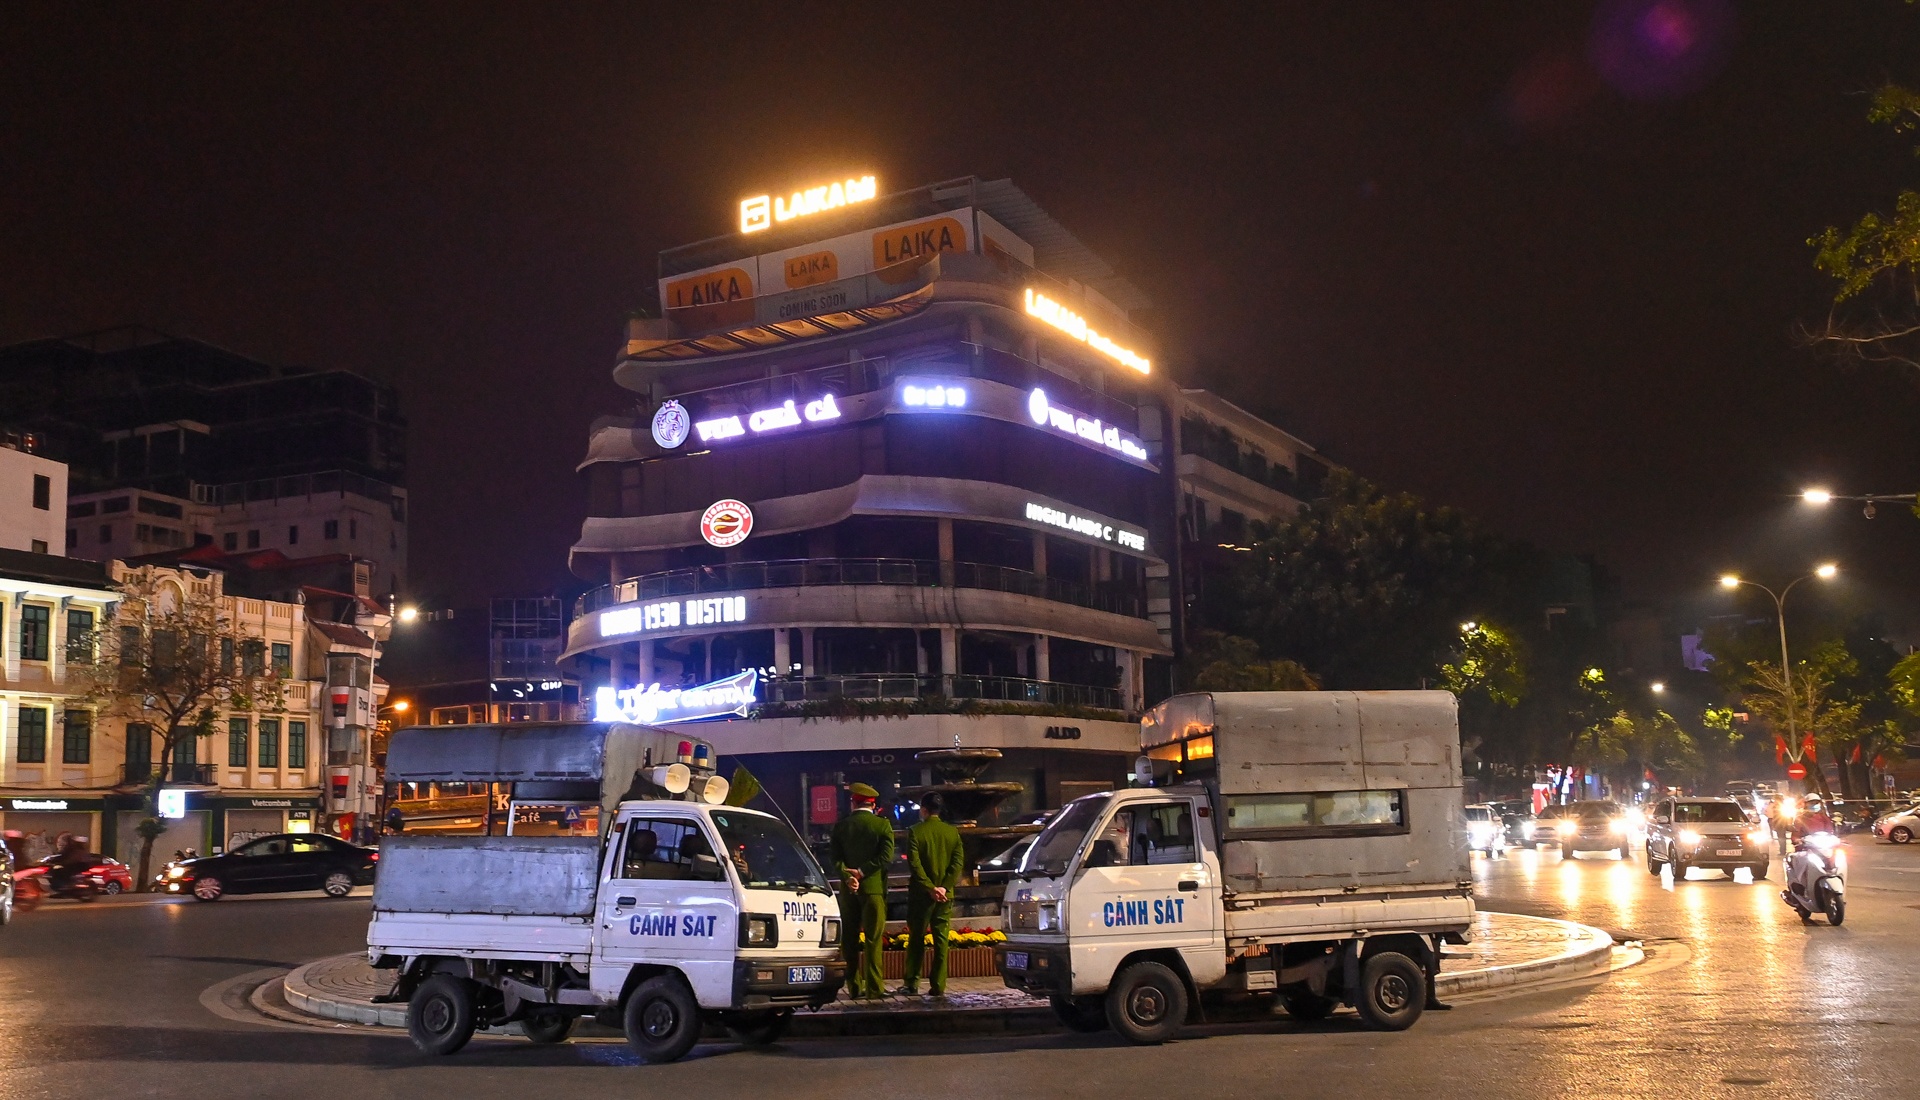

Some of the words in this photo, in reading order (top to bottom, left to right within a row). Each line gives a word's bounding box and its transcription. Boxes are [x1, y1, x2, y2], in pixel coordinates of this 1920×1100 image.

[884, 226, 955, 263] LAIKA
[789, 255, 831, 278] LAIKA
[677, 277, 742, 307] LAIKA
[779, 301, 817, 319] COMING
[820, 293, 847, 310] SOON
[703, 502, 750, 525] HIGHLANDS
[1026, 502, 1102, 538] HIGHLANDS
[1043, 725, 1081, 740] ALDO
[849, 754, 895, 764] ALDO
[251, 799, 291, 807] Vietcombank
[783, 901, 818, 923] POLICE
[1153, 895, 1184, 925] SÁT
